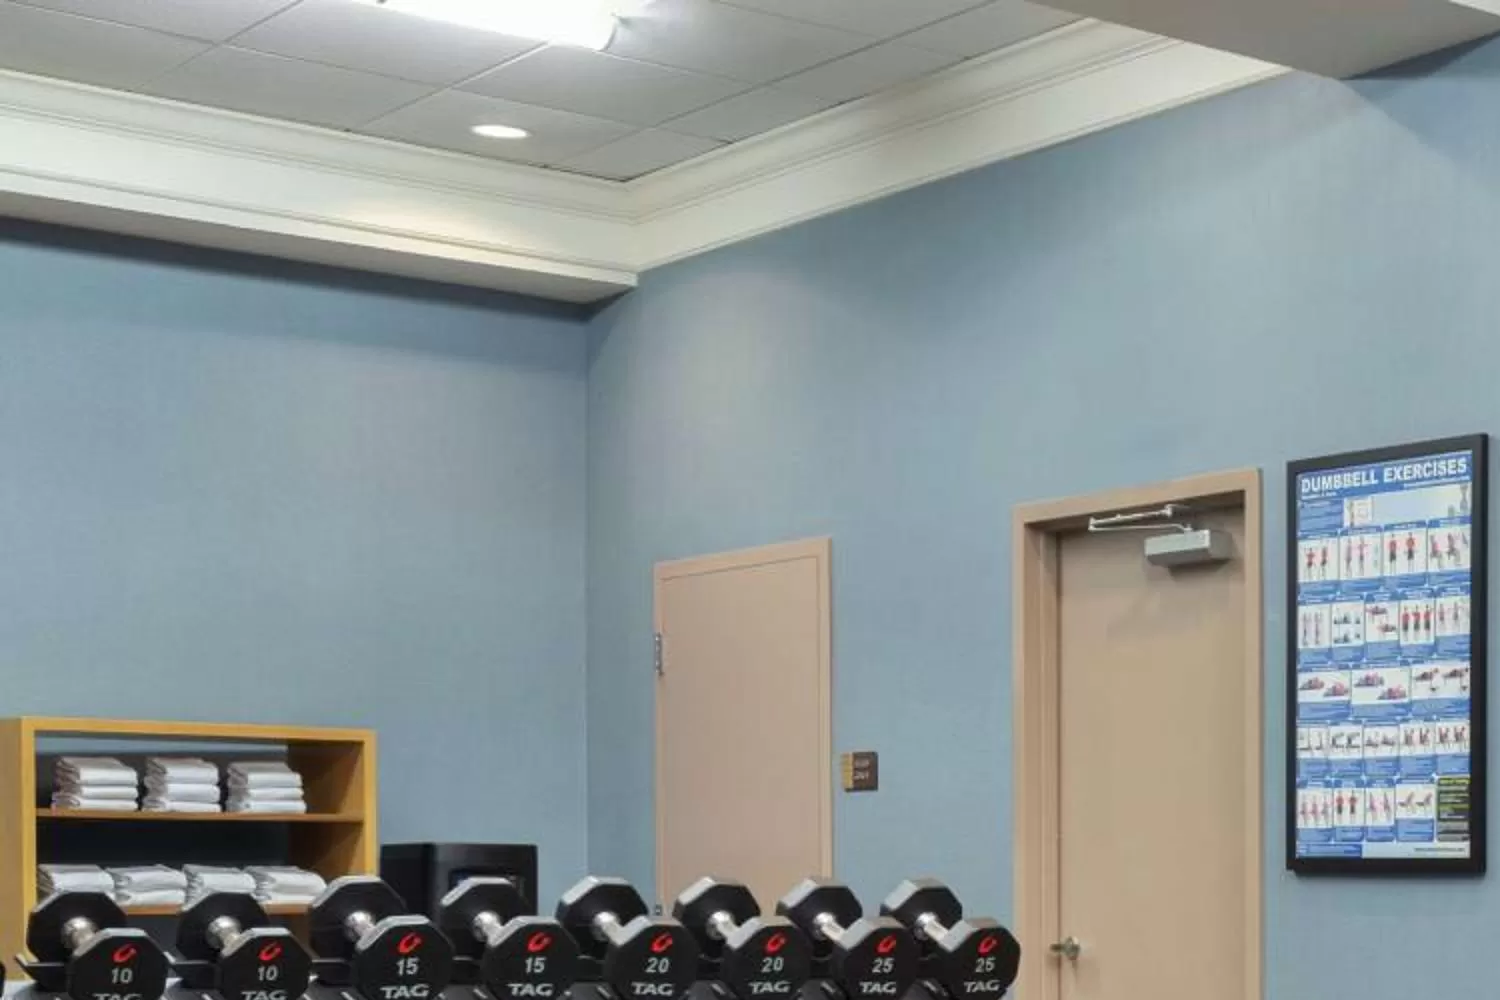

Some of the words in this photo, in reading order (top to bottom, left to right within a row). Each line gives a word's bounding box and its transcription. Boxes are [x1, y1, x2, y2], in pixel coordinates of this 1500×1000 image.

[1301, 469, 1378, 493] DUMBBELL
[1384, 458, 1467, 482] EXERCISES
[257, 965, 279, 981] 10
[396, 957, 419, 976] 15
[525, 956, 546, 974] 15
[645, 957, 670, 974] 20
[761, 956, 785, 973] 20
[871, 957, 895, 974] 25
[974, 956, 996, 973] 25
[111, 967, 133, 984] 10
[380, 983, 429, 1000] TAG
[507, 983, 553, 997] TAG
[631, 982, 673, 997] TAG
[749, 980, 790, 995] TAG
[859, 981, 897, 995] TAG
[963, 979, 1000, 993] TAG
